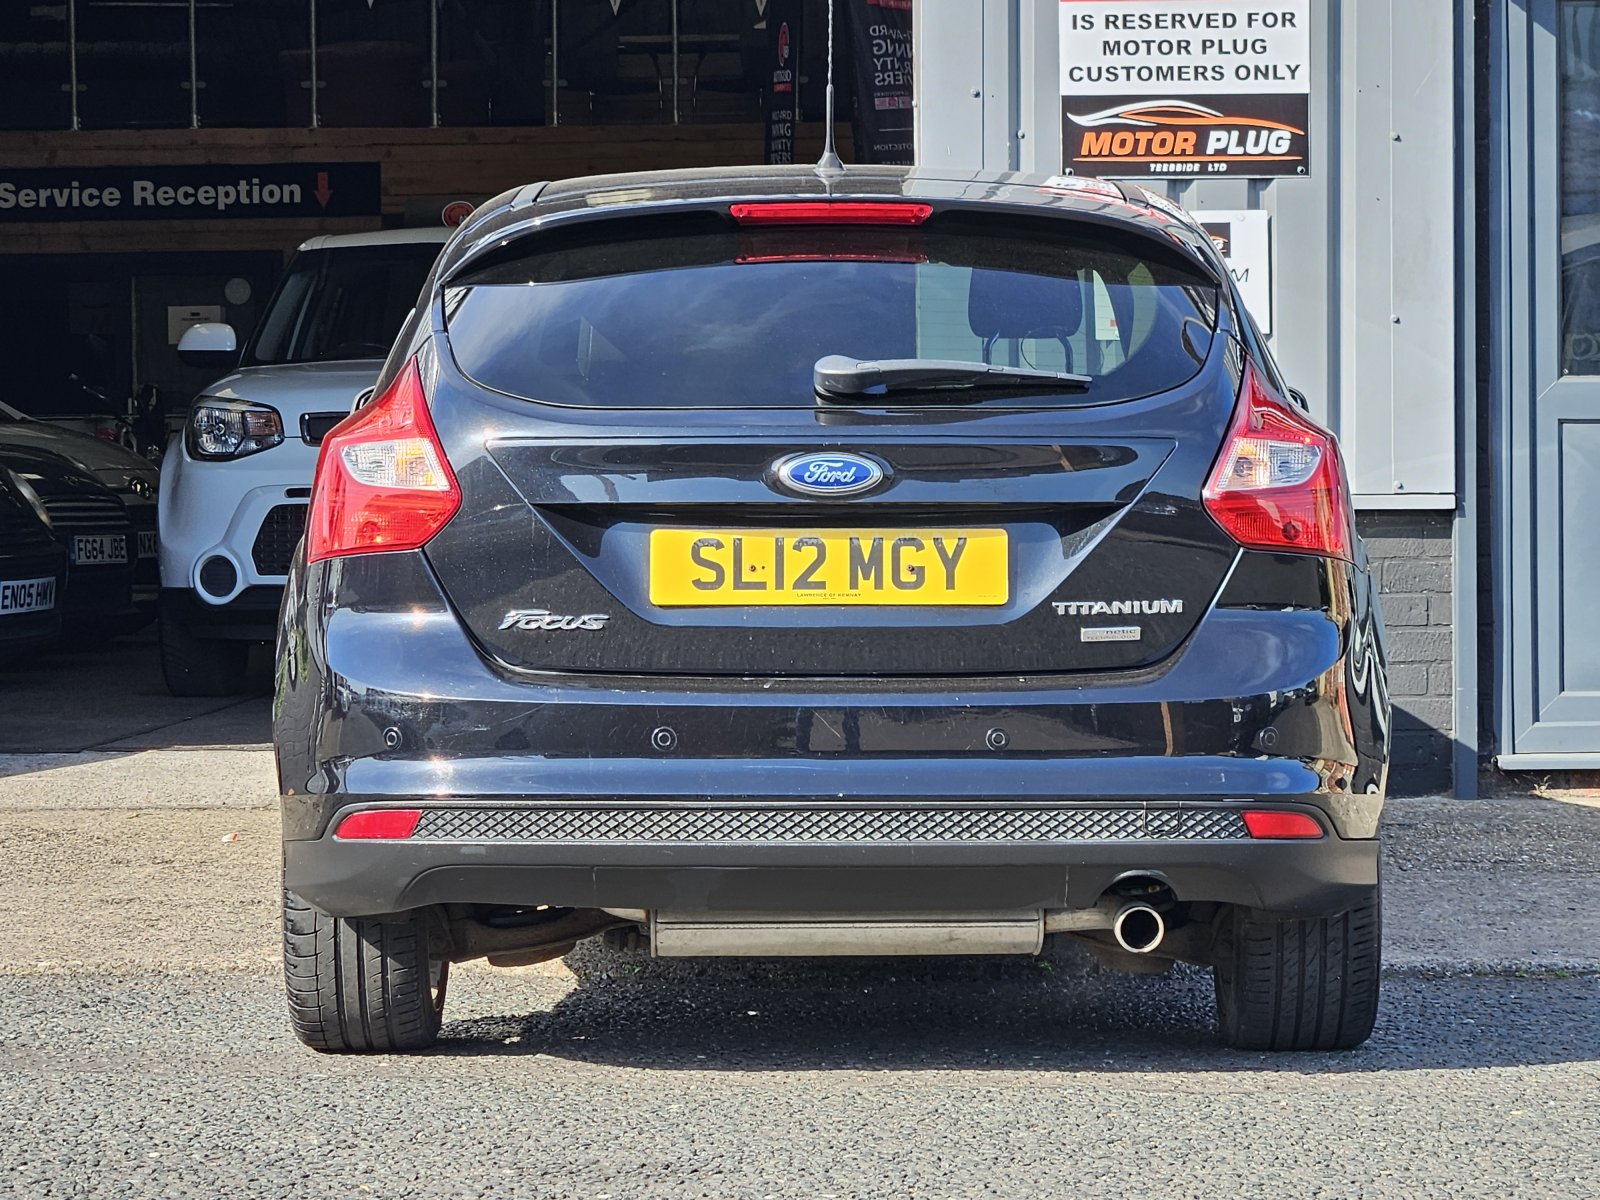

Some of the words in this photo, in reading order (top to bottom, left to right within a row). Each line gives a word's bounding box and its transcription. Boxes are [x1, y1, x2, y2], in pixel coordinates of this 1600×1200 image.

[1072, 14, 1094, 30] IS
[1104, 12, 1237, 30] RESERVED
[1247, 11, 1296, 29] FOR
[1102, 39, 1191, 56] MOTOR
[1202, 39, 1267, 55] PLUG
[1069, 65, 1225, 82] CUSTOMERS
[1235, 64, 1301, 81] ONLY
[1080, 131, 1196, 156] MOTOR
[1206, 130, 1291, 155] PLUG
[1150, 163, 1200, 172] TEESSIDE
[1208, 163, 1227, 172] LTD
[0, 181, 121, 209] Service
[133, 178, 302, 211] Reception
[804, 461, 855, 483] Ford
[77, 538, 104, 561] FG64
[108, 537, 126, 559] JBE
[691, 537, 827, 591] SL12
[849, 537, 968, 591] MGY
[1, 584, 35, 609] EN05
[1052, 599, 1183, 615] TITANIUM
[498, 608, 610, 630] Focus
